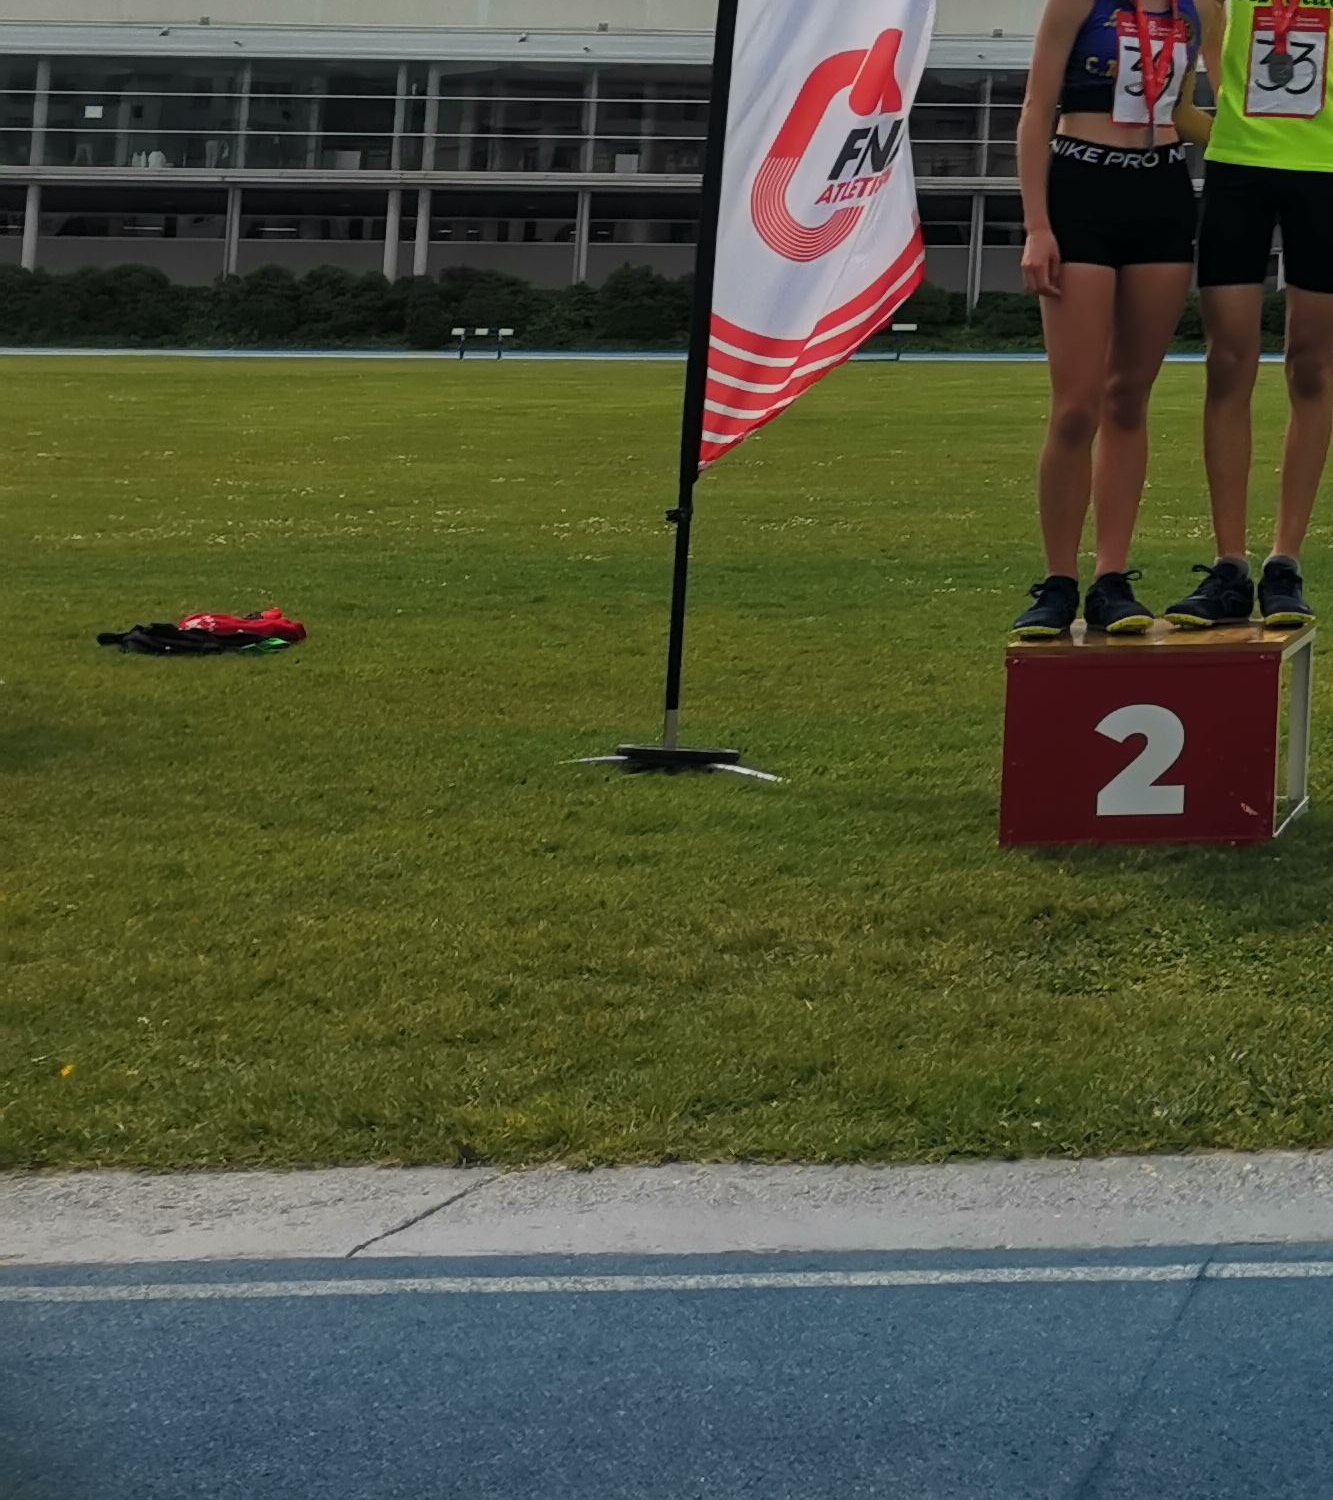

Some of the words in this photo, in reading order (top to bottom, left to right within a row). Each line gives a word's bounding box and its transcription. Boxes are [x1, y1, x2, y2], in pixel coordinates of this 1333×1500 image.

[1049, 138, 1105, 164] NIKE
[1103, 151, 1160, 169] PRO
[1094, 703, 1185, 817] 2
